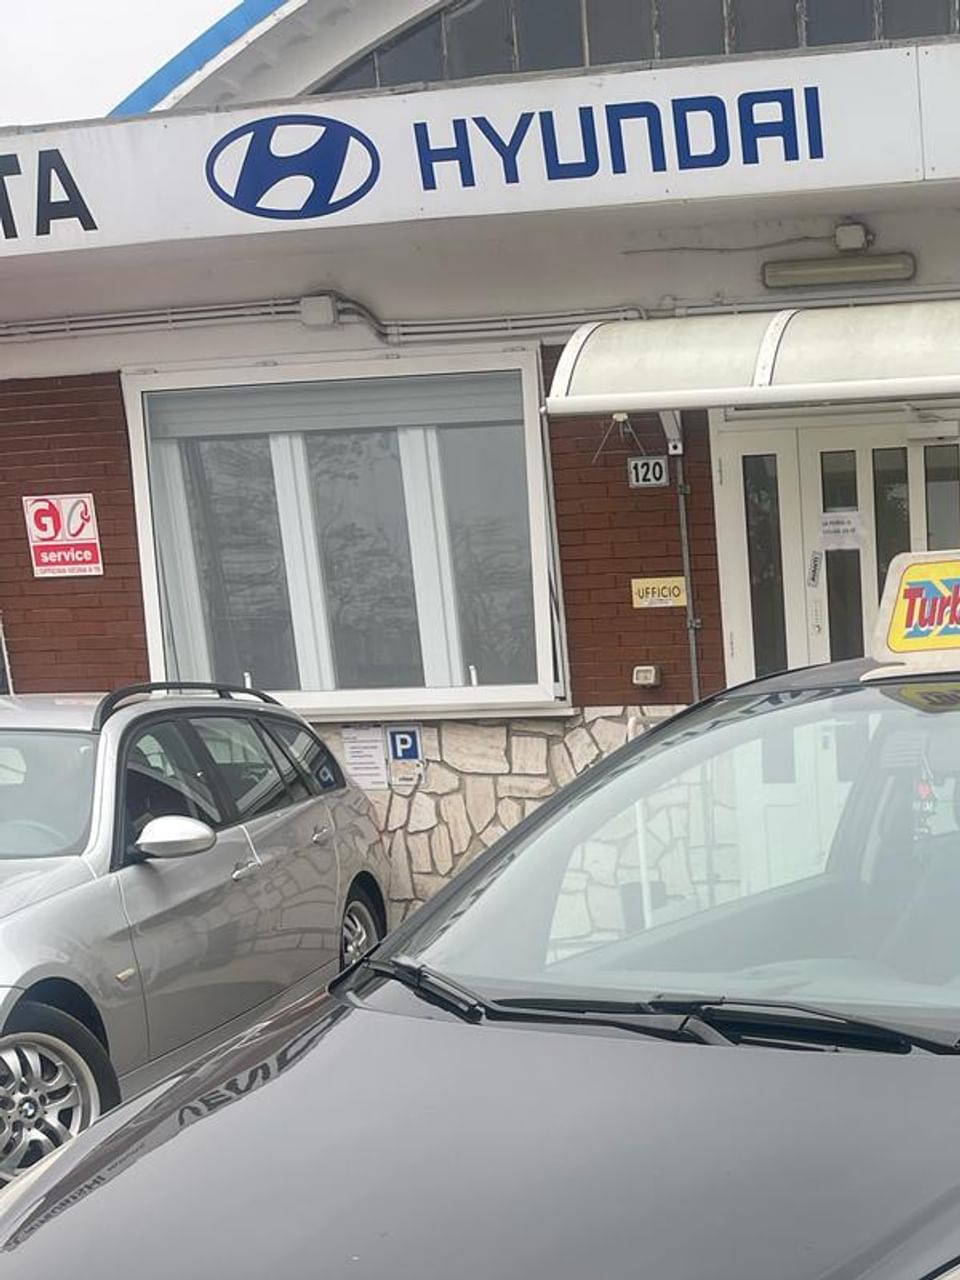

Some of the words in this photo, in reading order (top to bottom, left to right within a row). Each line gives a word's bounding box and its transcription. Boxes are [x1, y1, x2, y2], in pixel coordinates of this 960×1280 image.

[414, 86, 824, 191] HYUNDAI
[632, 461, 664, 483] 120
[40, 547, 92, 562] service
[638, 585, 681, 599] UFFICIO
[394, 733, 413, 758] P
